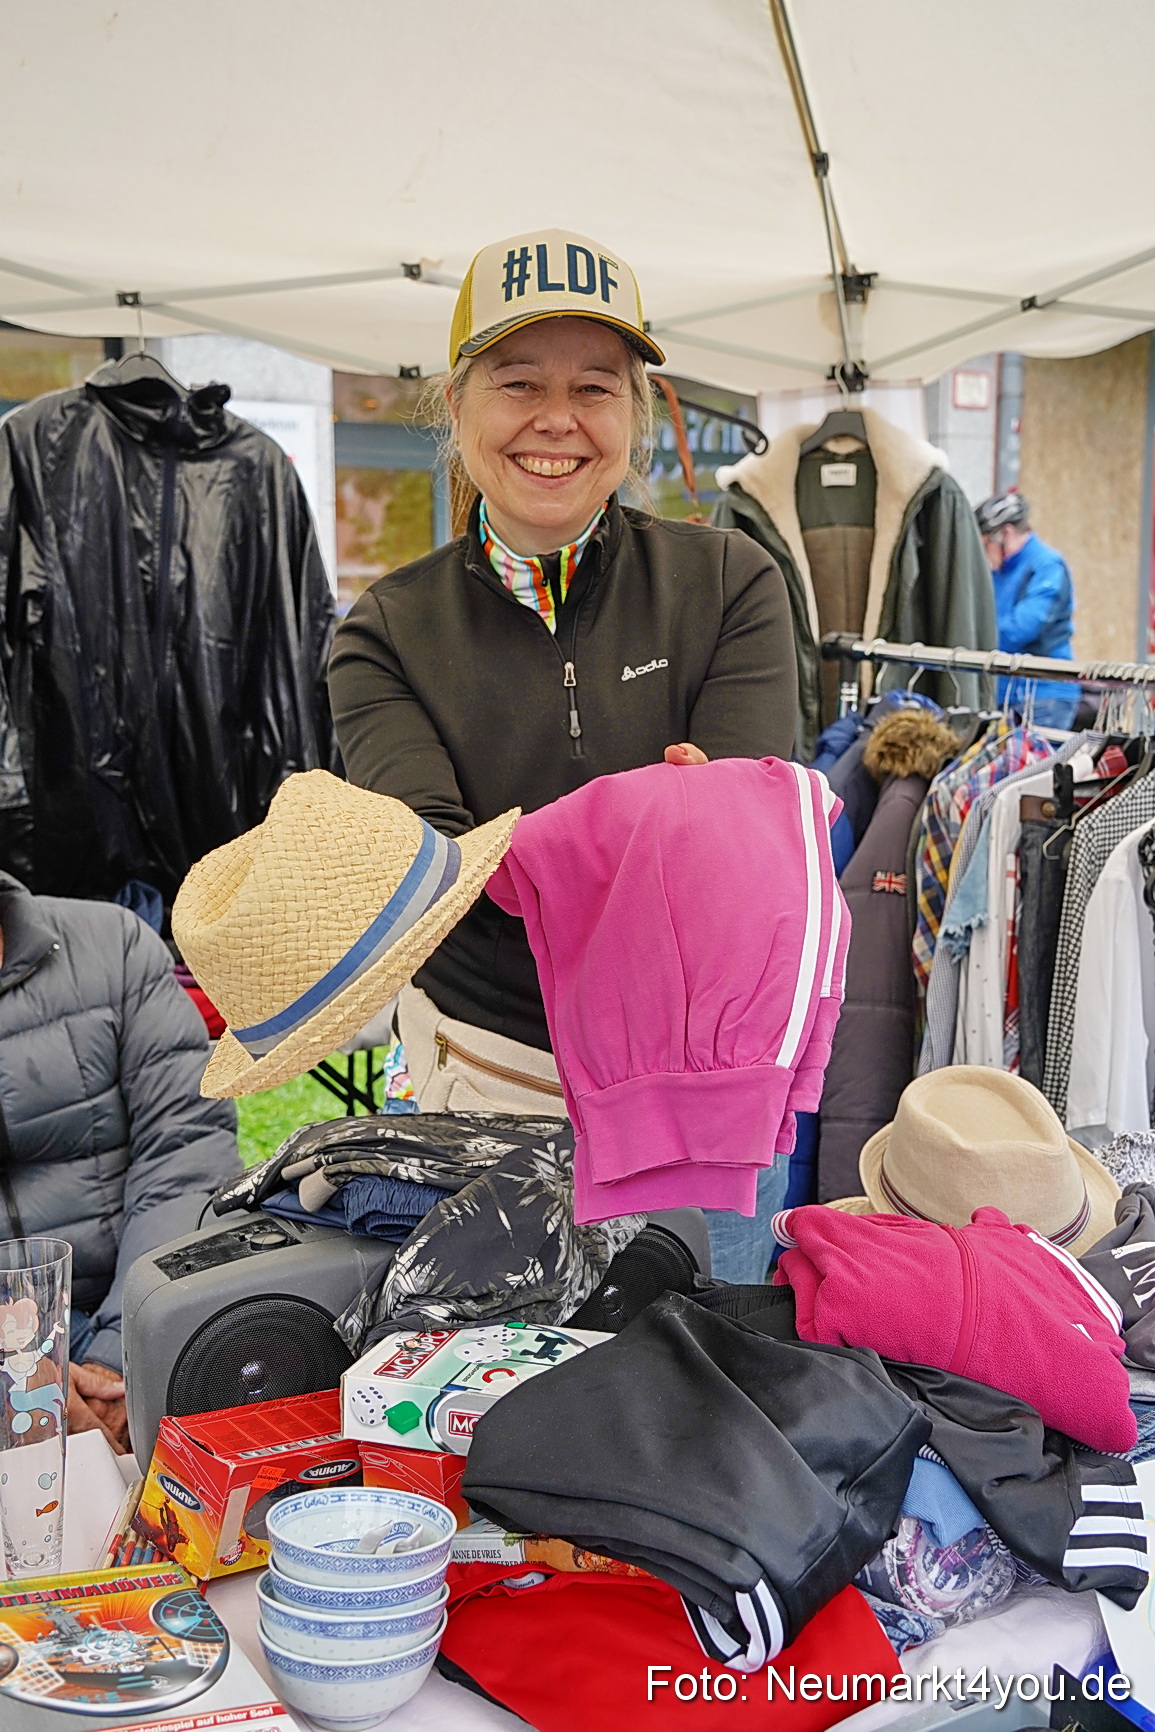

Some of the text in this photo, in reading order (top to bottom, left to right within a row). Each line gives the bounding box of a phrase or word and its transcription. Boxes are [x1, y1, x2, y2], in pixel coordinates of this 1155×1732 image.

[501, 243, 620, 305] #LDF
[634, 657, 670, 676] odlo
[382, 1329, 452, 1377] MONOPO
[307, 1462, 354, 1478] ALPINA
[164, 1476, 200, 1509] ALPINA
[451, 1549, 502, 1560] ANNE DE VRIES
[196, 1715, 214, 1727] auf
[216, 1711, 248, 1724] hoher
